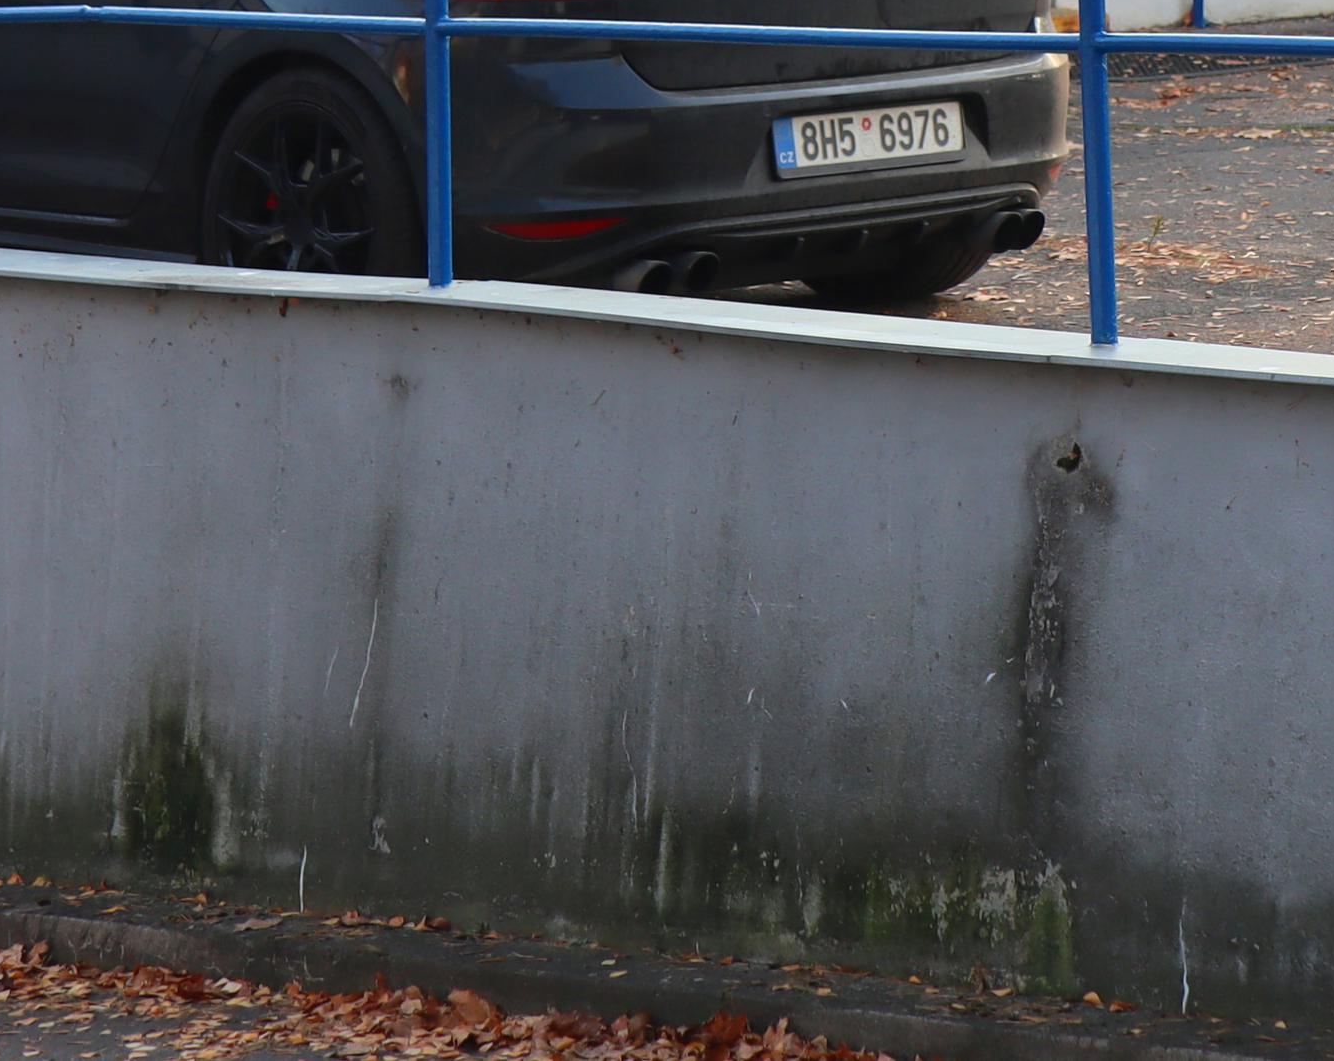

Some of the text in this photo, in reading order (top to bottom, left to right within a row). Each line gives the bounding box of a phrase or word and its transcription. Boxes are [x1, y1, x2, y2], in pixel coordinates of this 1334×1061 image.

[779, 108, 950, 165] CZ 8H5 6976
